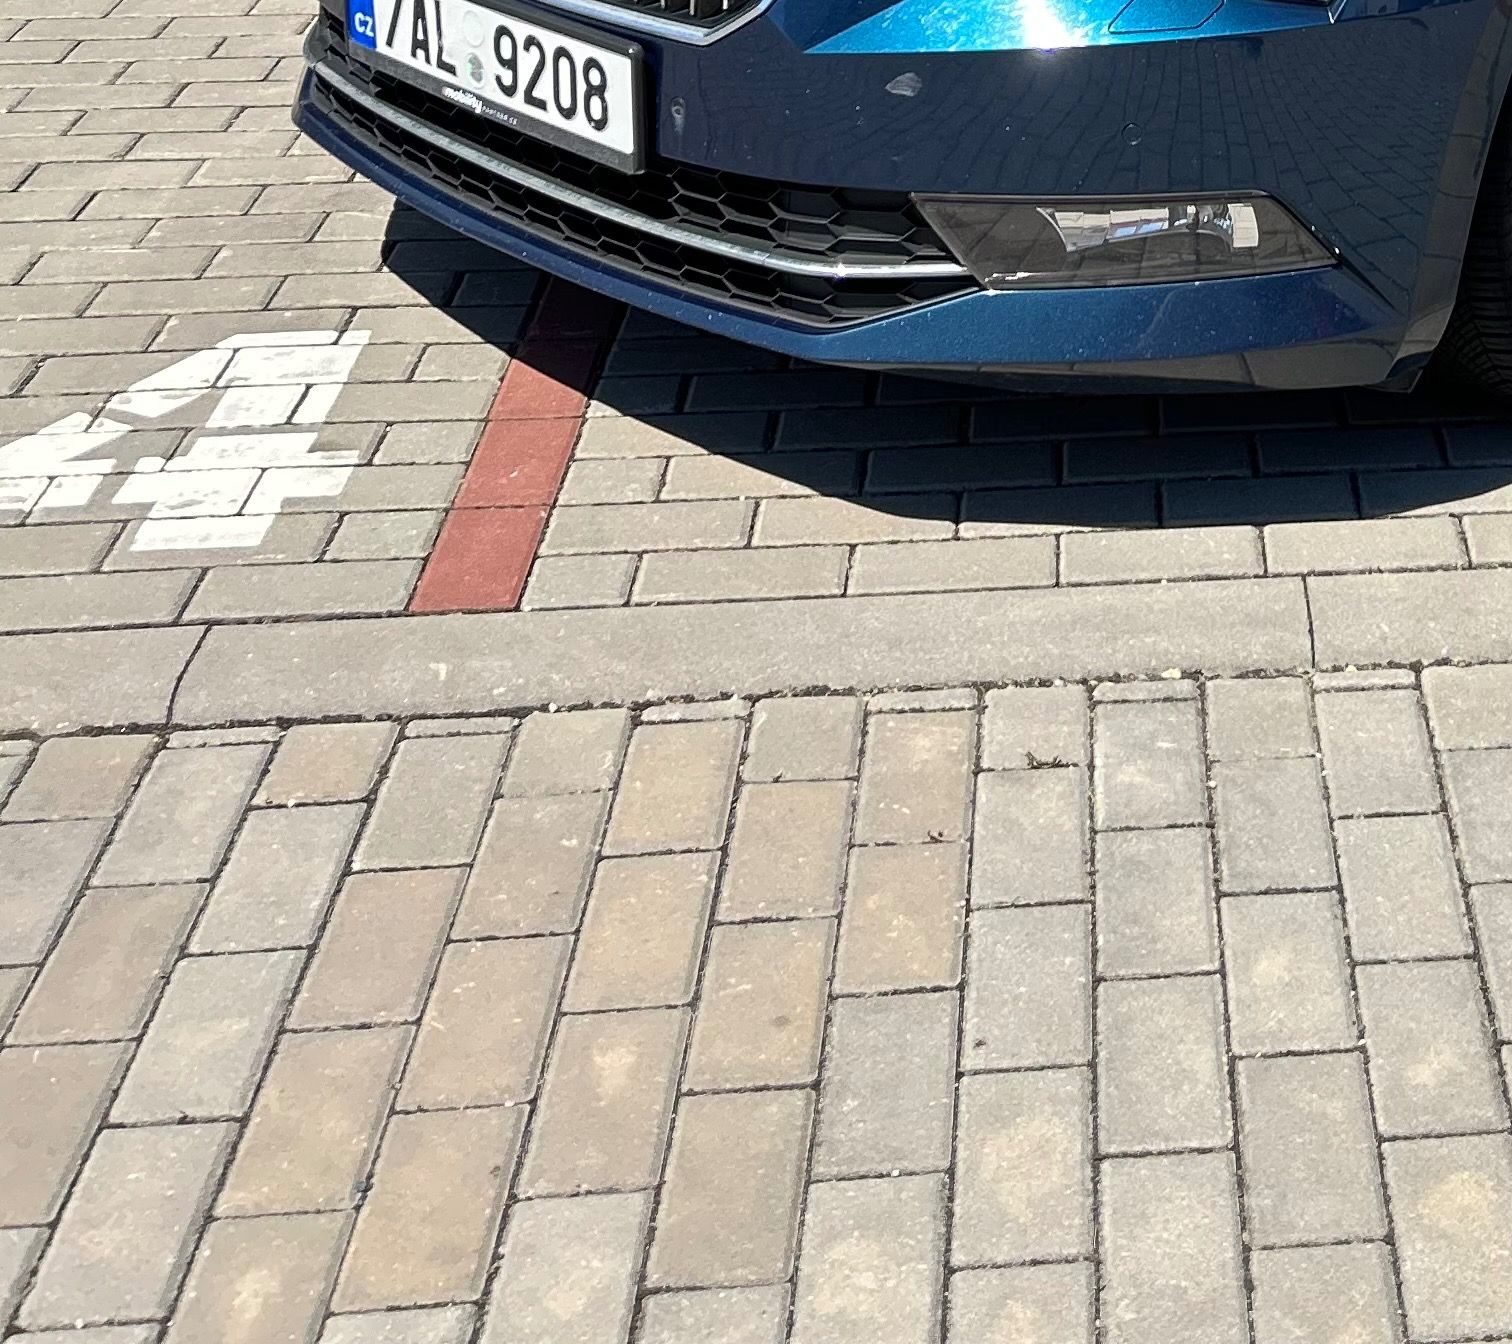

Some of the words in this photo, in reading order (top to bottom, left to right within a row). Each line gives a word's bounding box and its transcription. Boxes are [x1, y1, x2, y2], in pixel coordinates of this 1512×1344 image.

[354, 11, 374, 38] CZ
[493, 24, 608, 132] 9208
[0, 329, 372, 551] 4
